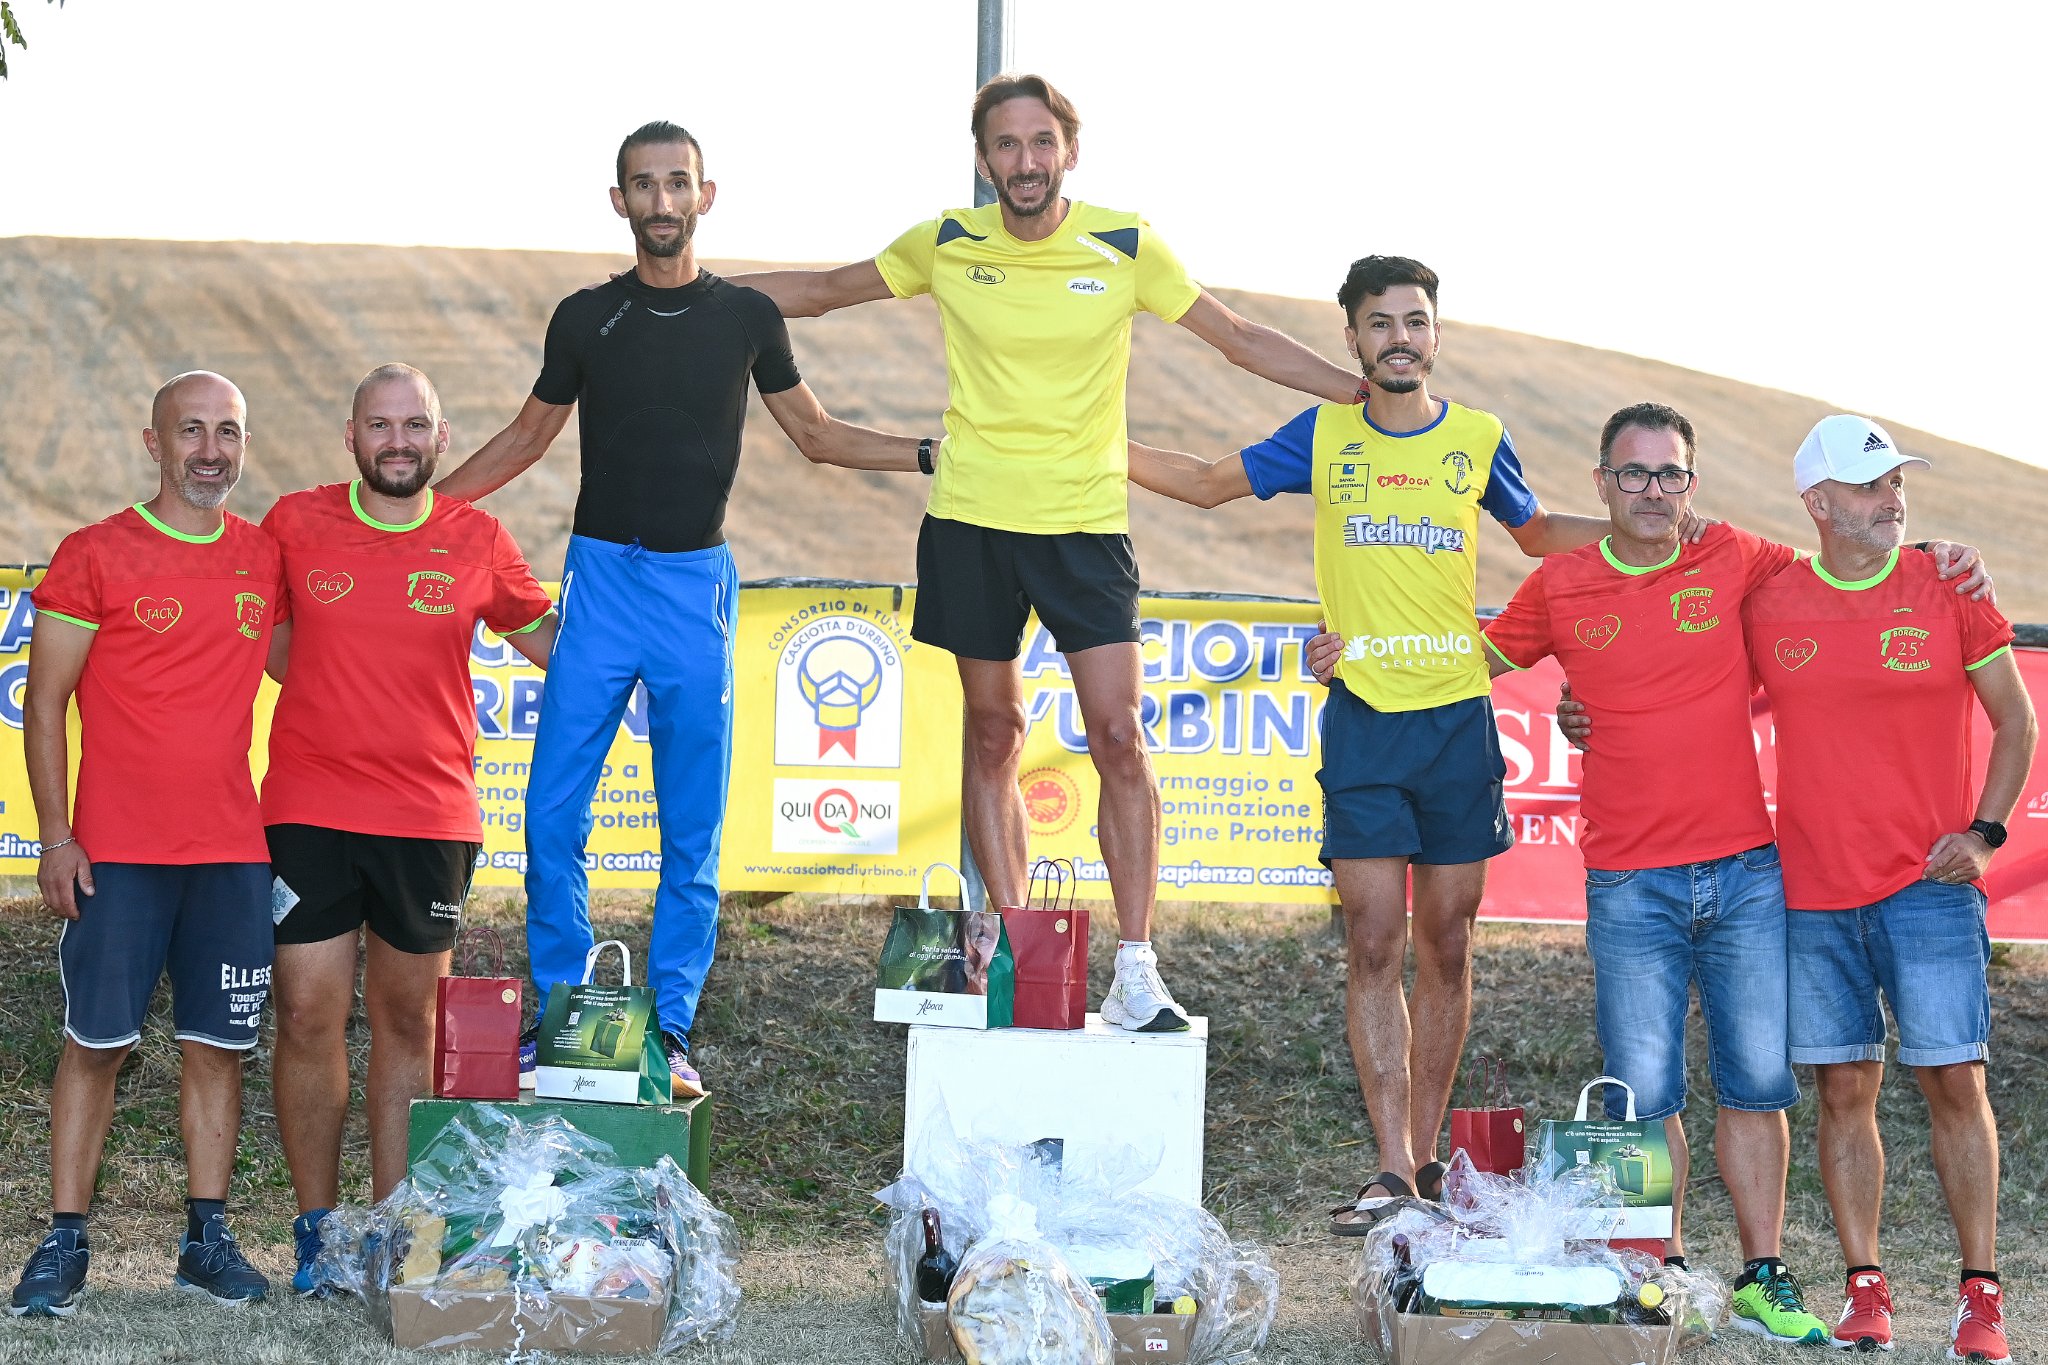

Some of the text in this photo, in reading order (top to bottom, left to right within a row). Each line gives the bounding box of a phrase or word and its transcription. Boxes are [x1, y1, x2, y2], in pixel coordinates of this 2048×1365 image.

[1863, 443, 1889, 453] adidas
[1345, 514, 1464, 554] Technipes
[313, 580, 344, 593] JACK
[143, 607, 176, 622] JACK
[768, 600, 846, 652] CONSORZIO
[852, 601, 869, 615] DI
[1584, 624, 1614, 643] JACK
[784, 620, 897, 667] CASCIOTTA D'URBINO
[1345, 630, 1473, 662] Formula
[1781, 648, 1809, 662] JACK
[1381, 657, 1458, 670] SERVIZI
[622, 764, 639, 778] a
[1278, 778, 1294, 793] a
[781, 801, 892, 823] QUI DA NOI
[744, 863, 918, 878] www.casciottadiurbino.it
[916, 952, 931, 961] oggi
[921, 944, 932, 953] Per
[940, 946, 960, 954] salute
[229, 1003, 250, 1013] WE
[916, 998, 944, 1016] Aboca
[572, 1074, 597, 1093] Aboca
